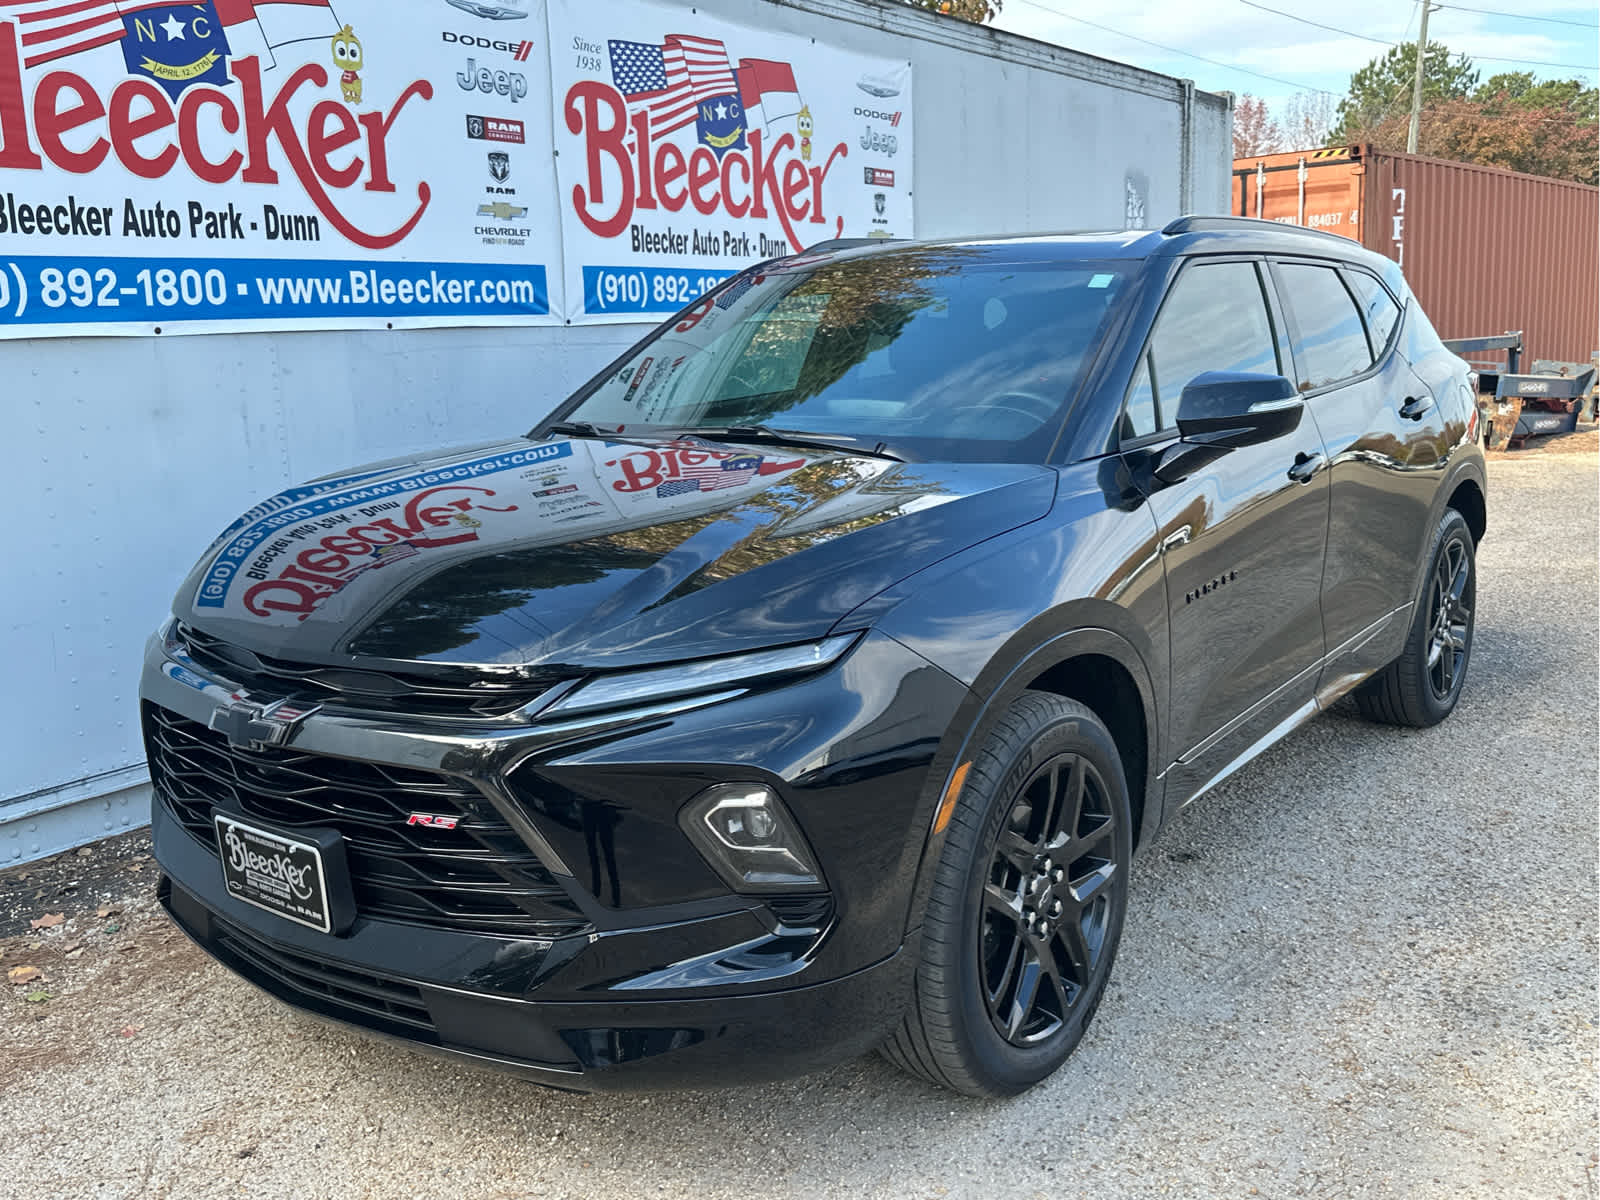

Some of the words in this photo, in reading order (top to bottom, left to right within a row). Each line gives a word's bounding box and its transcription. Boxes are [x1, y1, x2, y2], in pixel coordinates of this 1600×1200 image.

[442, 32, 521, 53] DODGE
[572, 37, 601, 54] Since
[156, 67, 180, 78] APRIL
[576, 55, 601, 72] 1938
[456, 58, 528, 103] Jeep
[488, 121, 521, 133] RAM
[854, 107, 895, 122] DODGE
[0, 20, 433, 250] leecker
[859, 126, 897, 158] Jeep
[564, 80, 848, 254] Bleecker
[486, 186, 516, 195] RAM
[123, 199, 180, 239] Auto
[190, 202, 244, 240] Park
[264, 205, 320, 241] Dunn
[474, 226, 531, 237] CHEVROLET
[631, 224, 688, 255] Bleecker
[692, 228, 719, 256] Auto
[723, 231, 750, 257] Park
[760, 233, 787, 258] Dunn
[40, 266, 226, 308] 892-1800
[256, 269, 535, 305] www.Bleecker.com
[597, 271, 648, 309] (910)
[406, 811, 459, 830] RS
[225, 832, 312, 900] Bleecker
